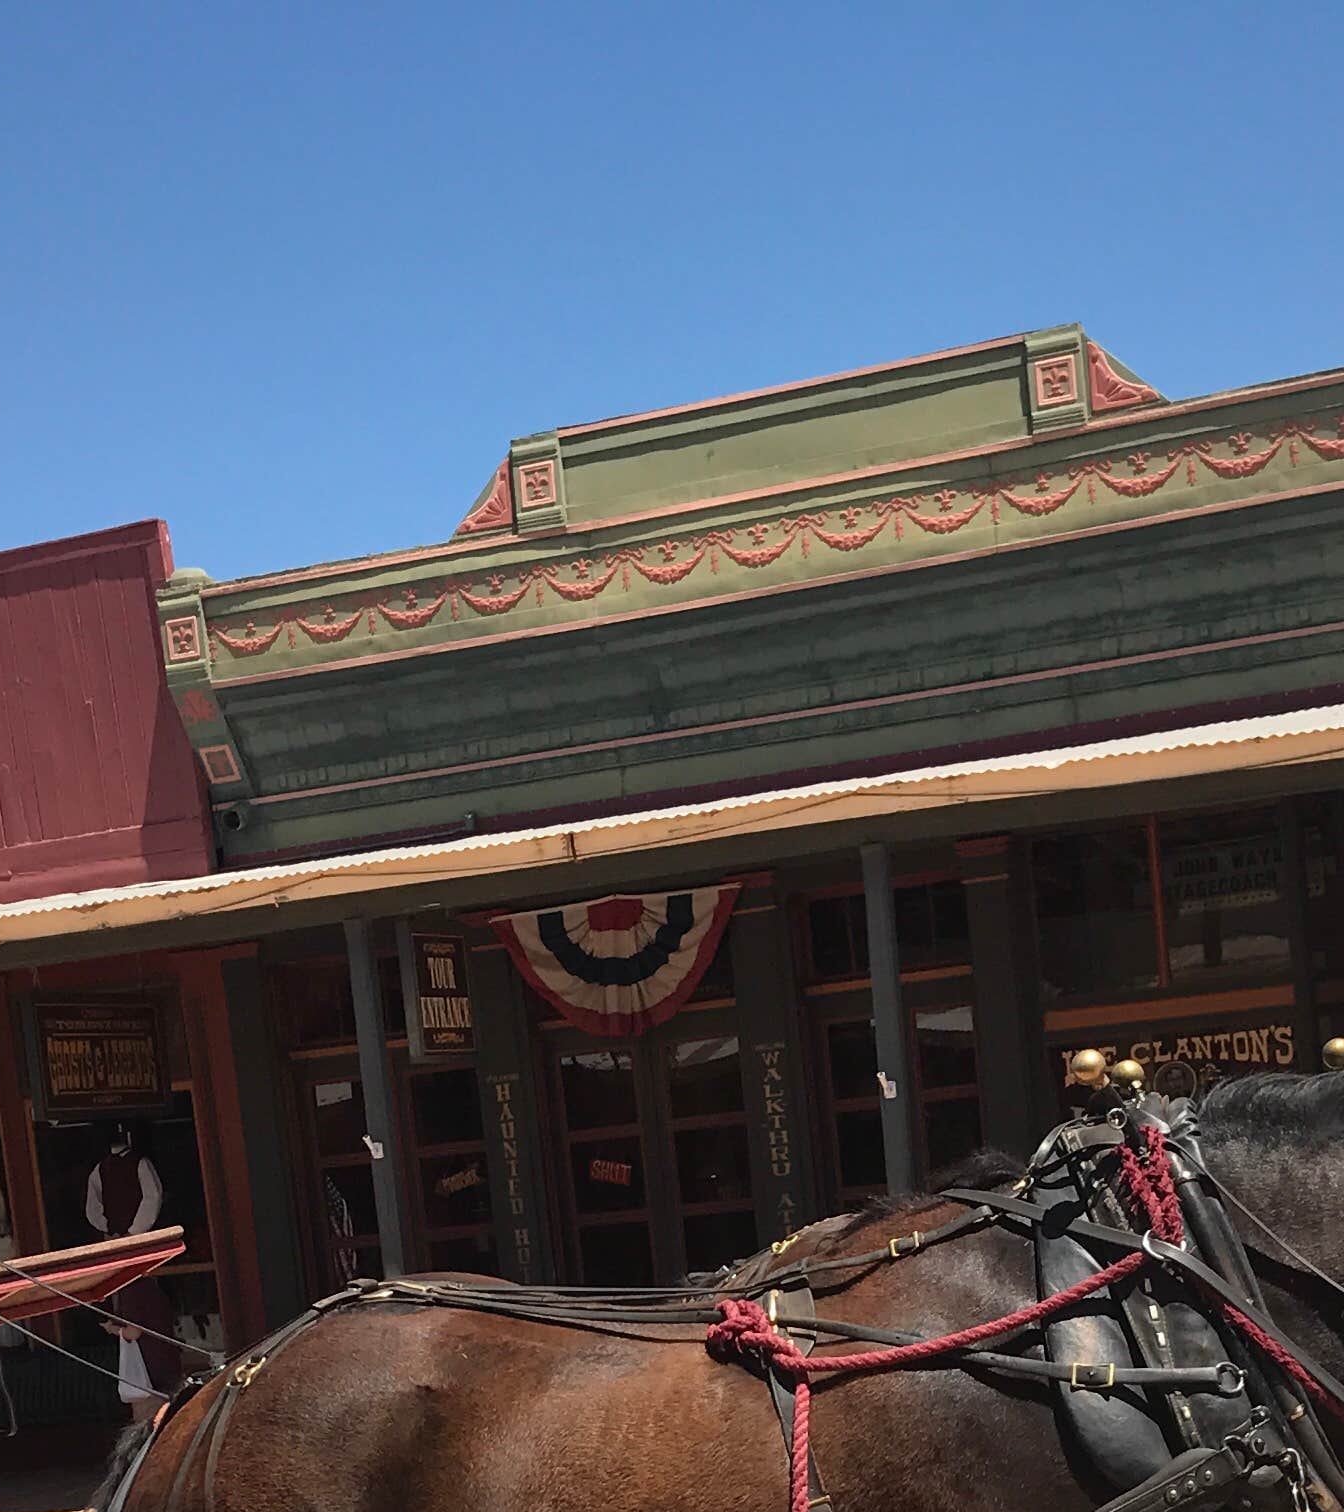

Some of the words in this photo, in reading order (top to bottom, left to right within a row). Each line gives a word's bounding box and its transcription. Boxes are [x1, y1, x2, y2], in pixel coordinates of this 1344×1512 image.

[427, 956, 457, 990] TOUR
[419, 996, 473, 1030] ENTRANCE
[1060, 1046, 1116, 1089] IE
[1129, 1024, 1295, 1065] CLANTON'S
[760, 1051, 793, 1177] WALKTHRU
[495, 1082, 524, 1215] HAUNTED
